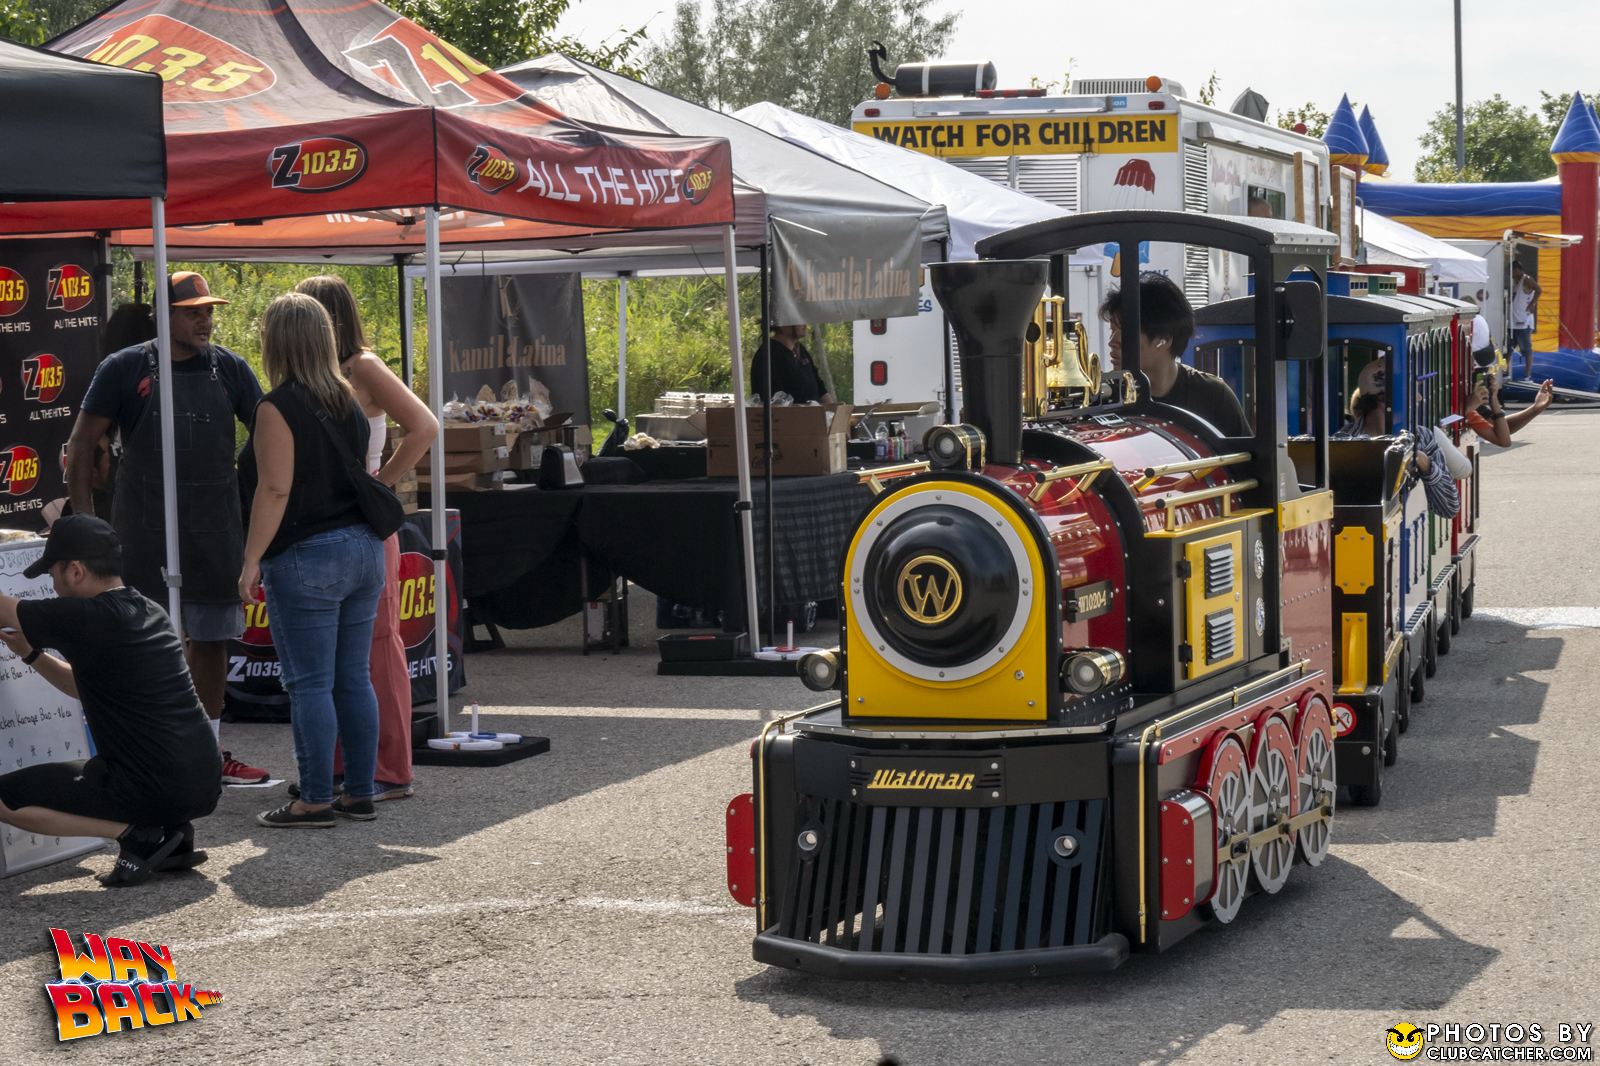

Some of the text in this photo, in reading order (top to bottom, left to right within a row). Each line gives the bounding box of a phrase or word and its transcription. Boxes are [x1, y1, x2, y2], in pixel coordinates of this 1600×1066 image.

[872, 120, 1166, 148] WATCH FOR CHILDREN
[272, 143, 358, 189] Z103.5
[516, 158, 684, 206] ALL THE HITS
[864, 257, 911, 299] Latina
[13, 321, 31, 332] HITS
[78, 316, 98, 327] HITS
[29, 411, 40, 421] ALL
[901, 562, 960, 621] W
[867, 768, 975, 790] Wattman
